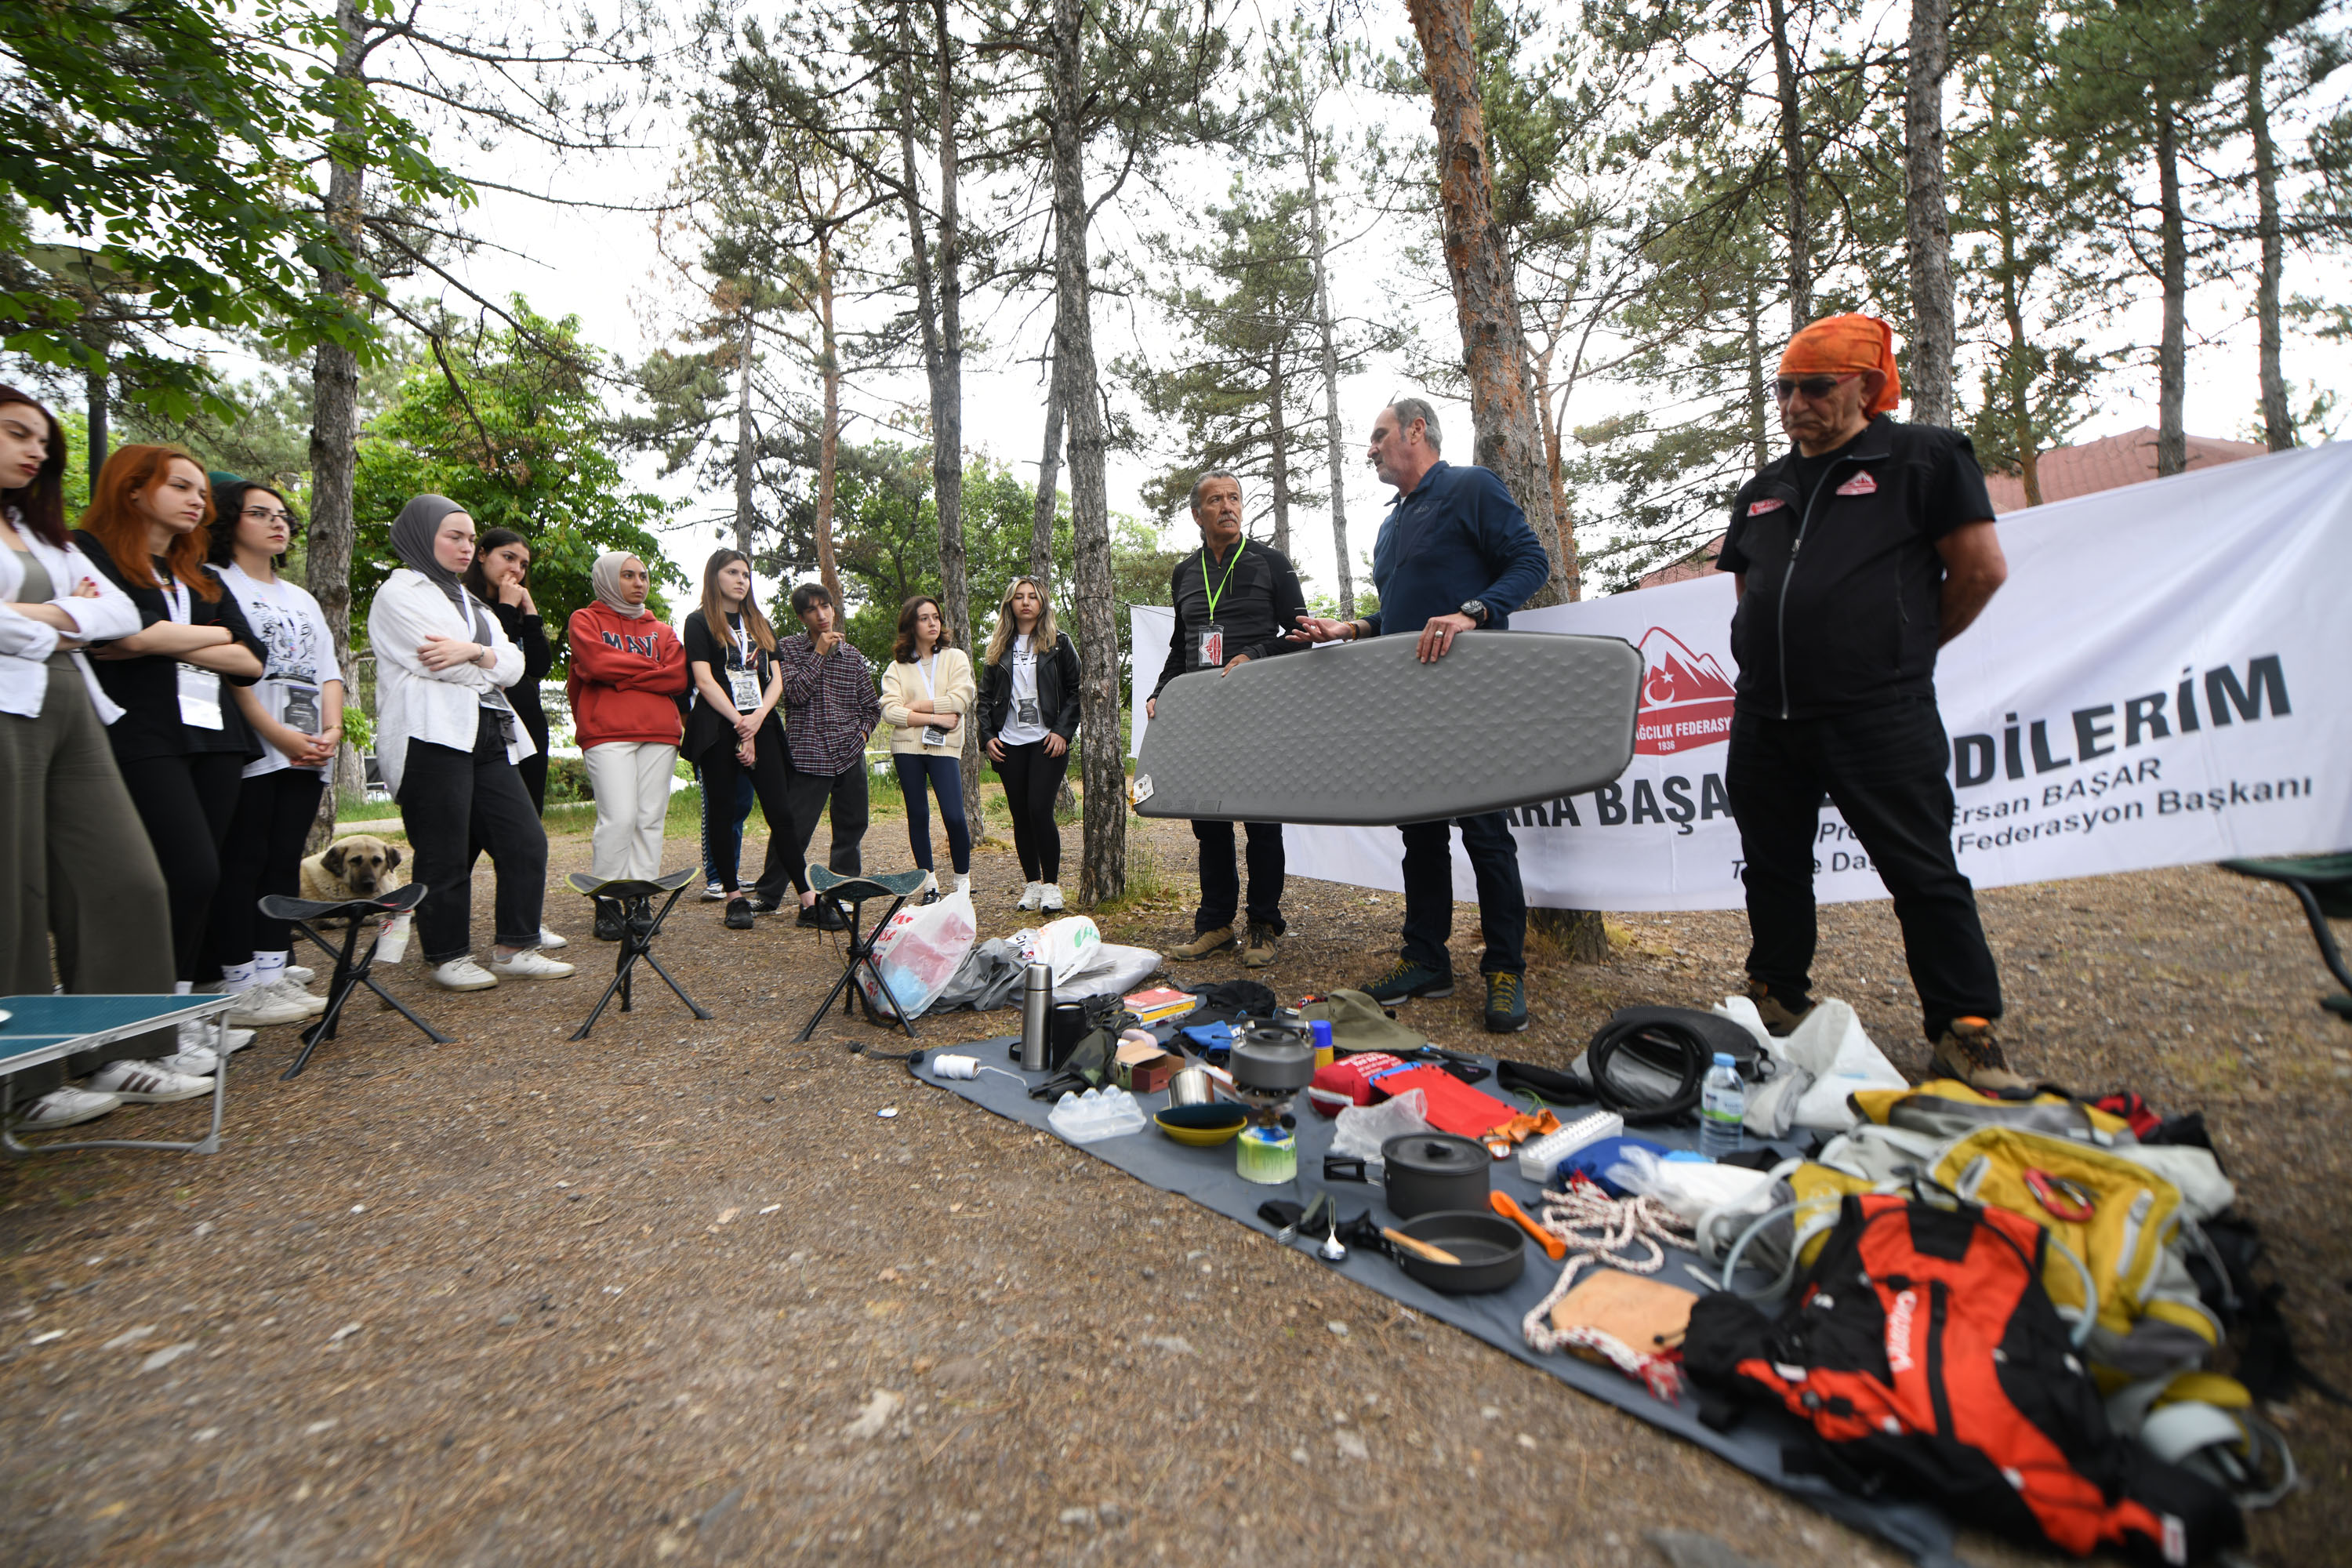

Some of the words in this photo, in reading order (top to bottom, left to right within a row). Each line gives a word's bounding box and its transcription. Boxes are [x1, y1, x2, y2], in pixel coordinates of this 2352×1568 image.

[1594, 774, 1734, 835] BAŞA
[1953, 654, 2292, 789] DİLERİM
[1635, 723, 1674, 741] AĞCILIK
[1675, 716, 1733, 737] FEDERASY
[1657, 740, 1675, 751] 1936
[2042, 757, 2162, 808] BAŞAR
[1957, 800, 2144, 854] Federasyon
[2157, 776, 2313, 815] Başkanı
